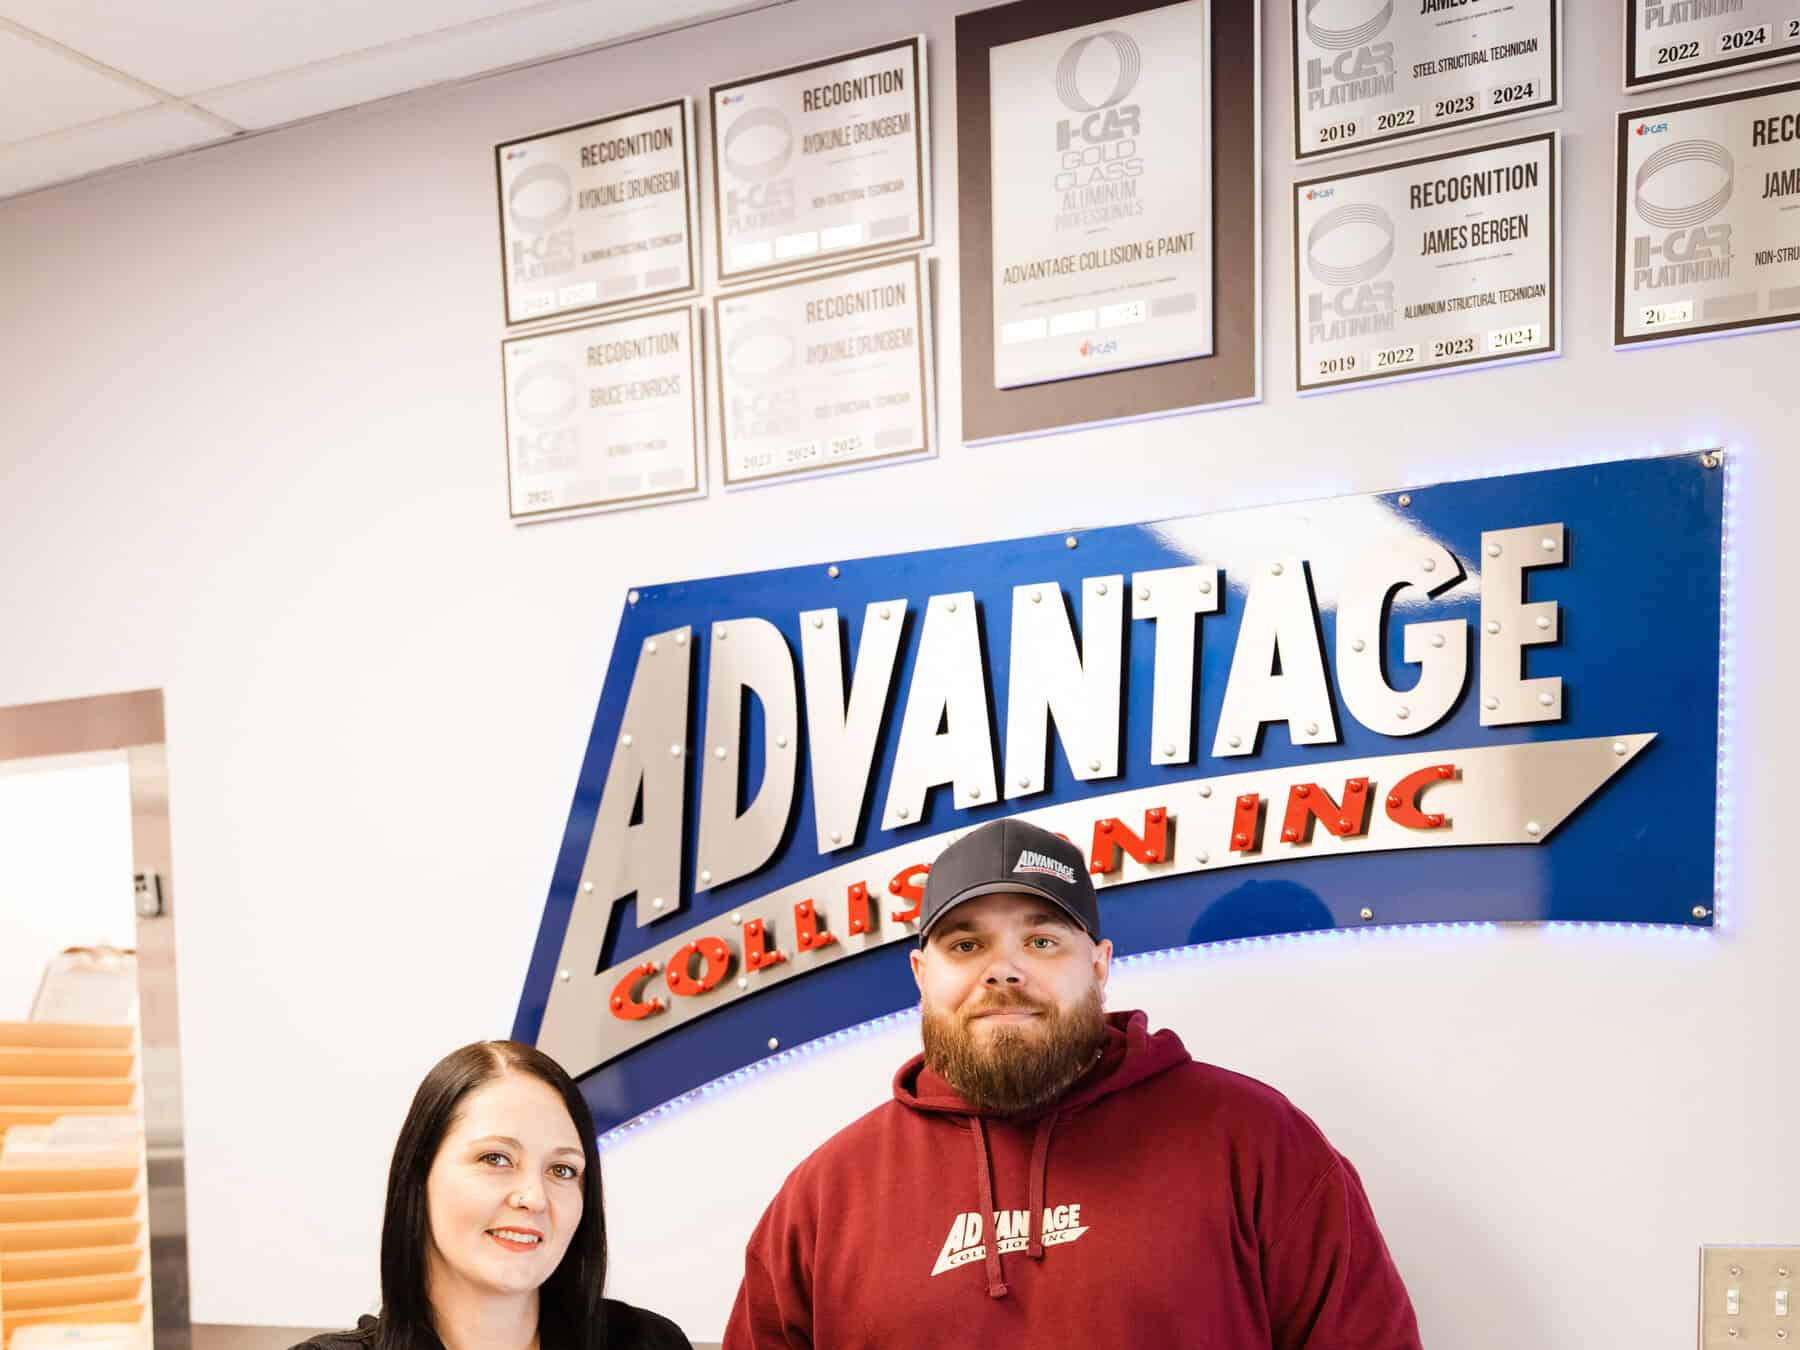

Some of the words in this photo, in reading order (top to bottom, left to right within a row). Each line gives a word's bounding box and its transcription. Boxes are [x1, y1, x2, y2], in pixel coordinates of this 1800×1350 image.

[1413, 62, 1437, 79] STEEL
[1438, 49, 1488, 73] STRUCTURAL
[1490, 38, 1538, 62] TECHNICIAN
[1658, 42, 1699, 64] 2022
[1721, 28, 1766, 51] 2024
[802, 68, 904, 112] RECOGNITION
[1307, 74, 1394, 111] PLATINUM
[1056, 104, 1141, 152] I-CAR
[1319, 122, 1356, 143] 2019
[1377, 110, 1415, 130] 2022
[1435, 96, 1475, 117] 2023
[1493, 82, 1534, 105] 2024
[581, 126, 673, 168] RECOGNITION
[1062, 140, 1136, 170] GOLD
[1055, 158, 1144, 192] CLASS
[1062, 180, 1137, 210] ALUMINUM
[1410, 162, 1539, 210] RECOGNITION
[1421, 225, 1468, 256] JAMES
[1471, 214, 1529, 248] BERGEN
[1633, 223, 1733, 268] I-CAR
[1003, 255, 1076, 284] ADVANTAGE
[1079, 243, 1142, 271] COLLISION
[1145, 240, 1155, 259] &
[1158, 232, 1196, 257] PAINT
[1633, 257, 1731, 291] PLATINUM
[805, 285, 907, 324] RECOGNITION
[1404, 299, 1446, 320] ALUMINUM
[1447, 291, 1497, 313] STRUCTURAL
[1498, 283, 1546, 306] TECHNICIAN
[586, 331, 681, 368] RECOGNITION
[1319, 356, 1356, 375] 2019
[1377, 347, 1415, 367] 2022
[1434, 338, 1474, 358] 2023
[1494, 328, 1534, 347] 2024
[562, 522, 1565, 975] ADVANTAGE
[1012, 849, 1074, 876] ADVANTAGE
[609, 805, 1167, 1021] COLLISN
[1230, 763, 1456, 852] INC
